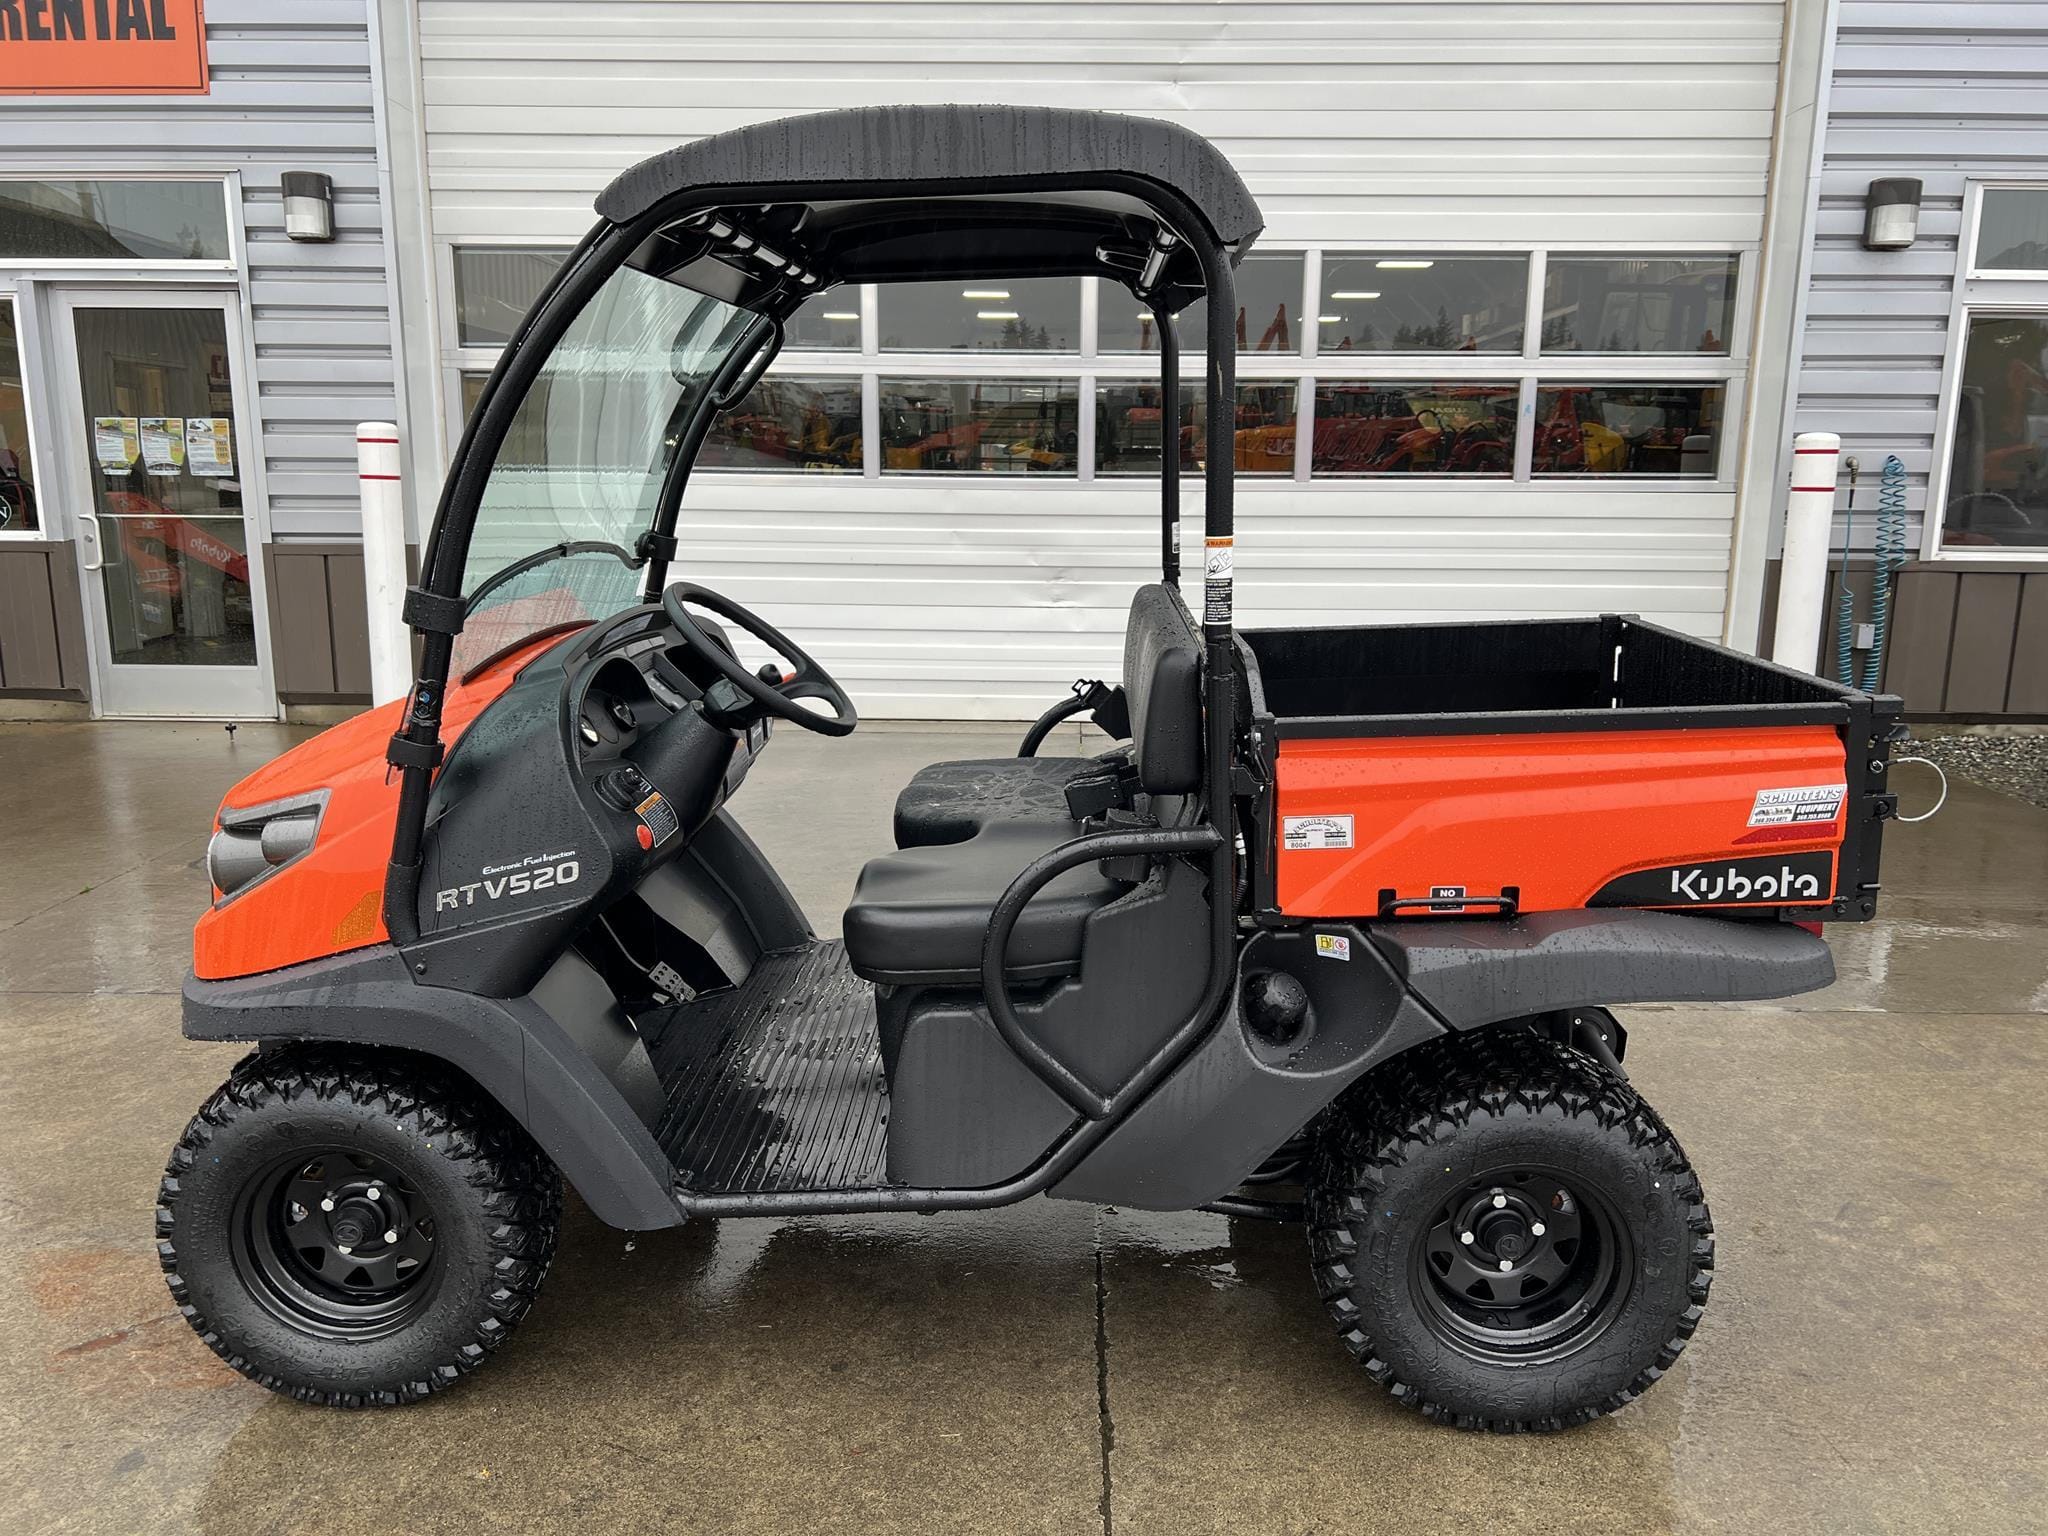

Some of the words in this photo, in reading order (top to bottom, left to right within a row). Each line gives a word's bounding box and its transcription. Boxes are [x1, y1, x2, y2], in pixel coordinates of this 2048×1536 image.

[1759, 789, 1842, 805] SCHOLTEN'S
[1796, 803, 1837, 814] EQUIPMENT
[482, 862, 522, 875] Electronic
[523, 856, 542, 867] Fuel
[543, 850, 576, 862] Injection
[436, 861, 579, 912] RTV520
[1440, 889, 1456, 897] NO
[1671, 866, 1818, 901] Kubota
